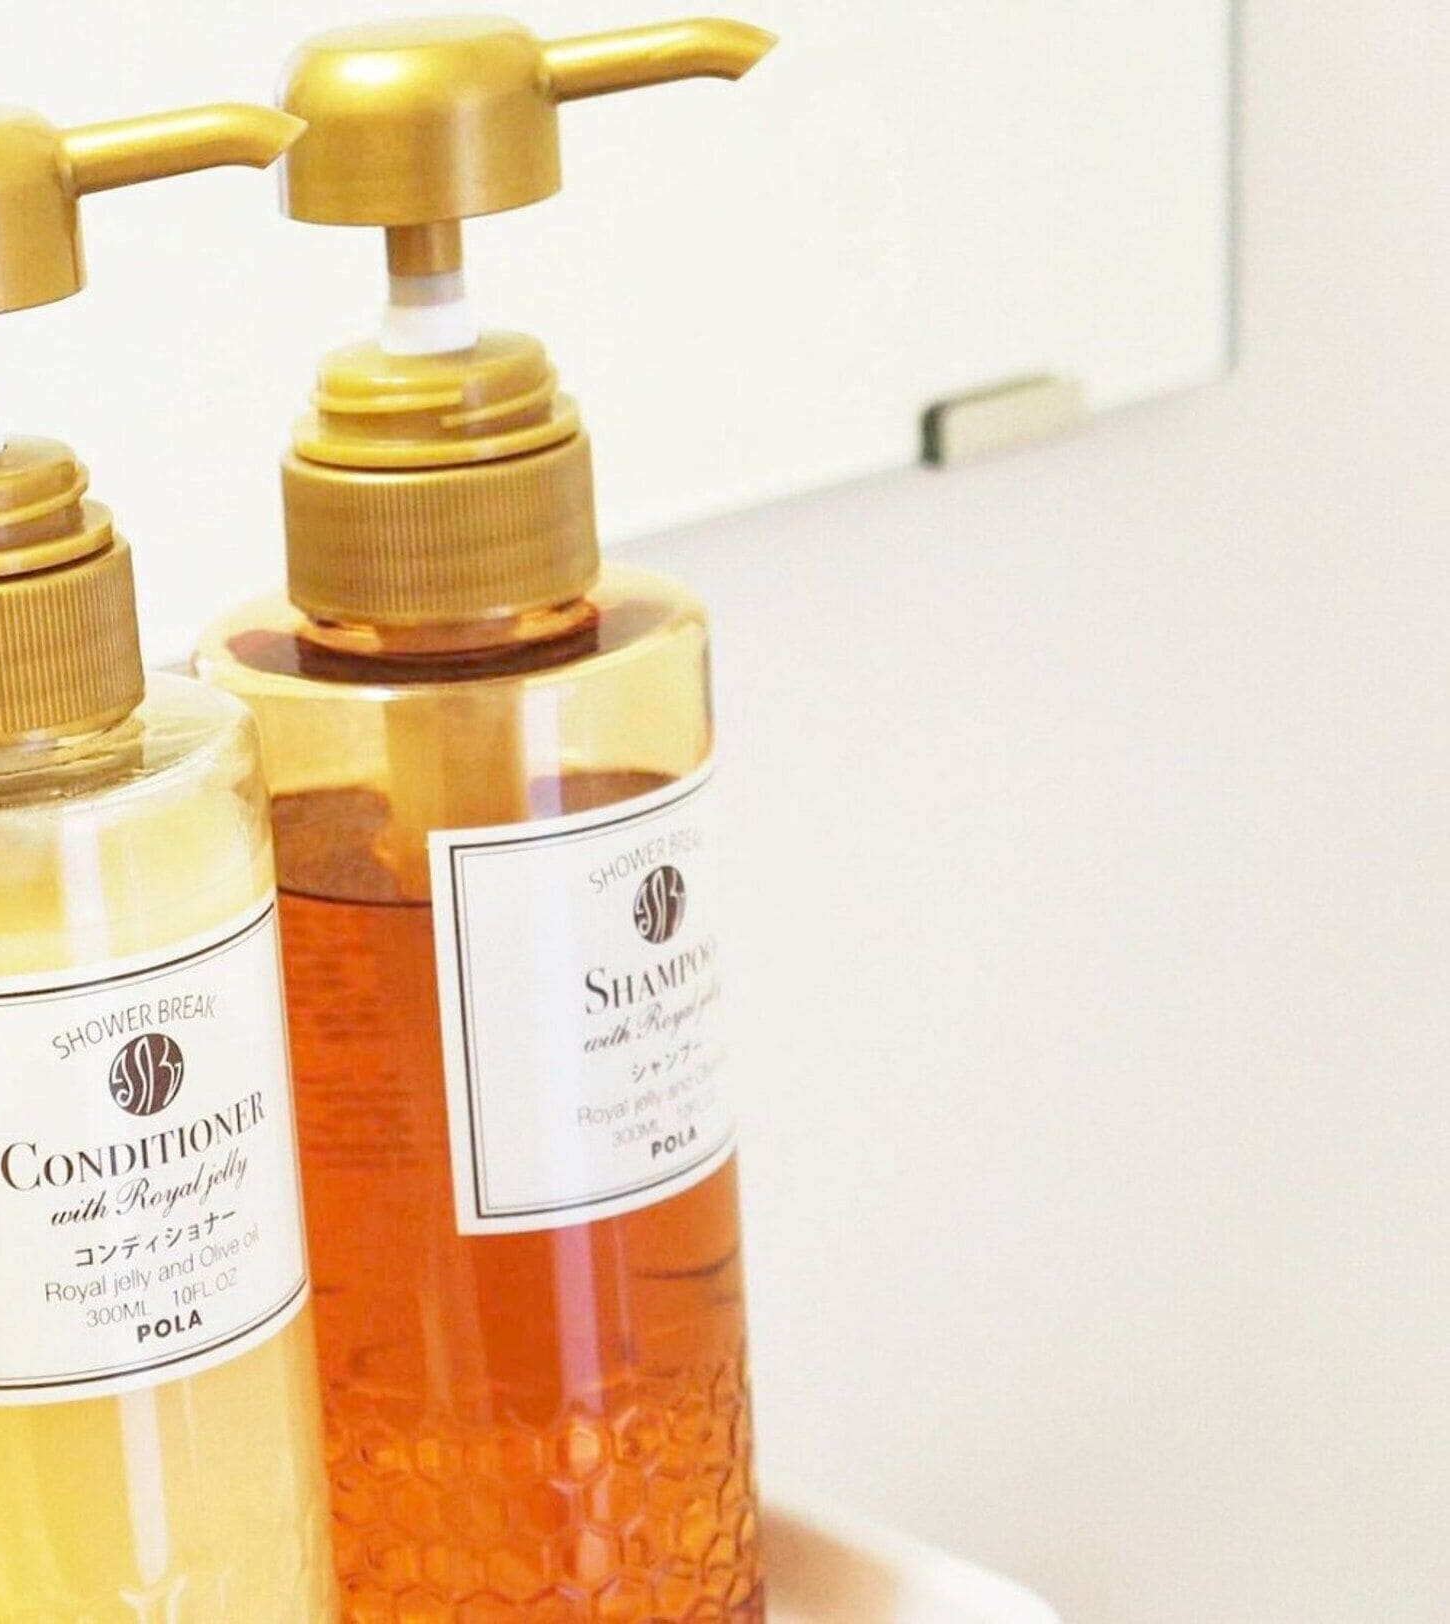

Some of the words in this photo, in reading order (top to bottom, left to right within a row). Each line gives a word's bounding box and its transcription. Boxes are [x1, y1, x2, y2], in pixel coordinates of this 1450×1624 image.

[589, 838, 665, 894] SHOWER
[52, 1004, 152, 1060] SHOWER
[158, 994, 218, 1023] BREAK
[584, 1017, 630, 1052] with
[1, 1090, 265, 1191] CONDITIONER
[651, 1126, 696, 1159] POLA
[51, 1191, 108, 1226] with
[115, 1164, 204, 1218] Royal
[201, 1148, 248, 1204] jelly
[46, 1275, 106, 1303] Royal
[113, 1267, 151, 1297] jelly
[159, 1255, 194, 1282] and
[200, 1240, 240, 1267] Olive
[239, 1225, 259, 1248] oil
[75, 1209, 236, 1267] コンディショナー
[86, 1301, 150, 1328] 300ML
[137, 1310, 203, 1342] POLA
